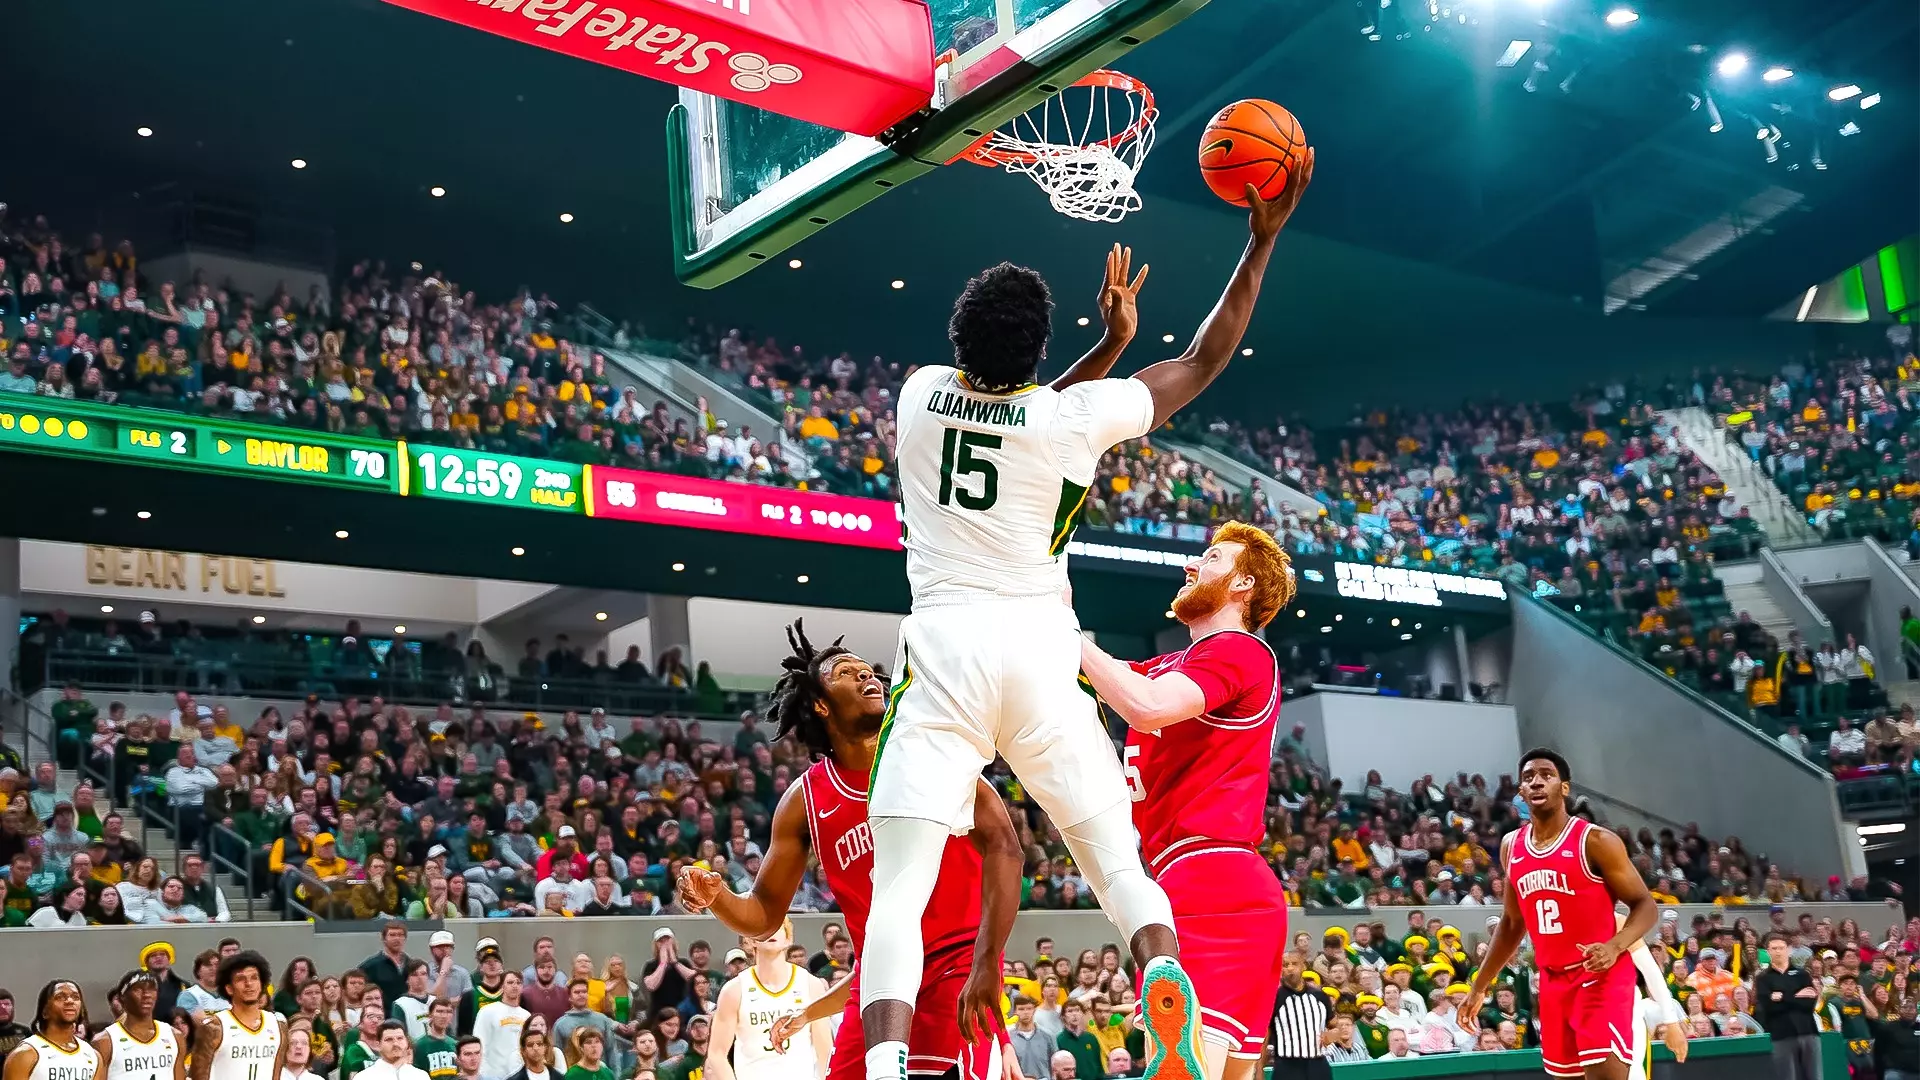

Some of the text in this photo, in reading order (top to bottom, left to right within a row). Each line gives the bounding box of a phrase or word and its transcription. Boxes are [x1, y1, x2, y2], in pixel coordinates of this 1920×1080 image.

[926, 390, 1026, 427] OJIANWUNA
[130, 429, 187, 454] FLS 2
[245, 438, 385, 479] BAYLOR 70
[418, 452, 523, 499] 12:59
[938, 427, 1003, 511] 15
[530, 487, 577, 507] HALF
[789, 505, 803, 525] 2
[86, 544, 287, 598] BEAR FUEL
[1517, 868, 1576, 900] CORNELL
[1535, 899, 1564, 935] 12
[124, 1054, 174, 1072] BAYLOR
[231, 1046, 277, 1059] BAYLOR
